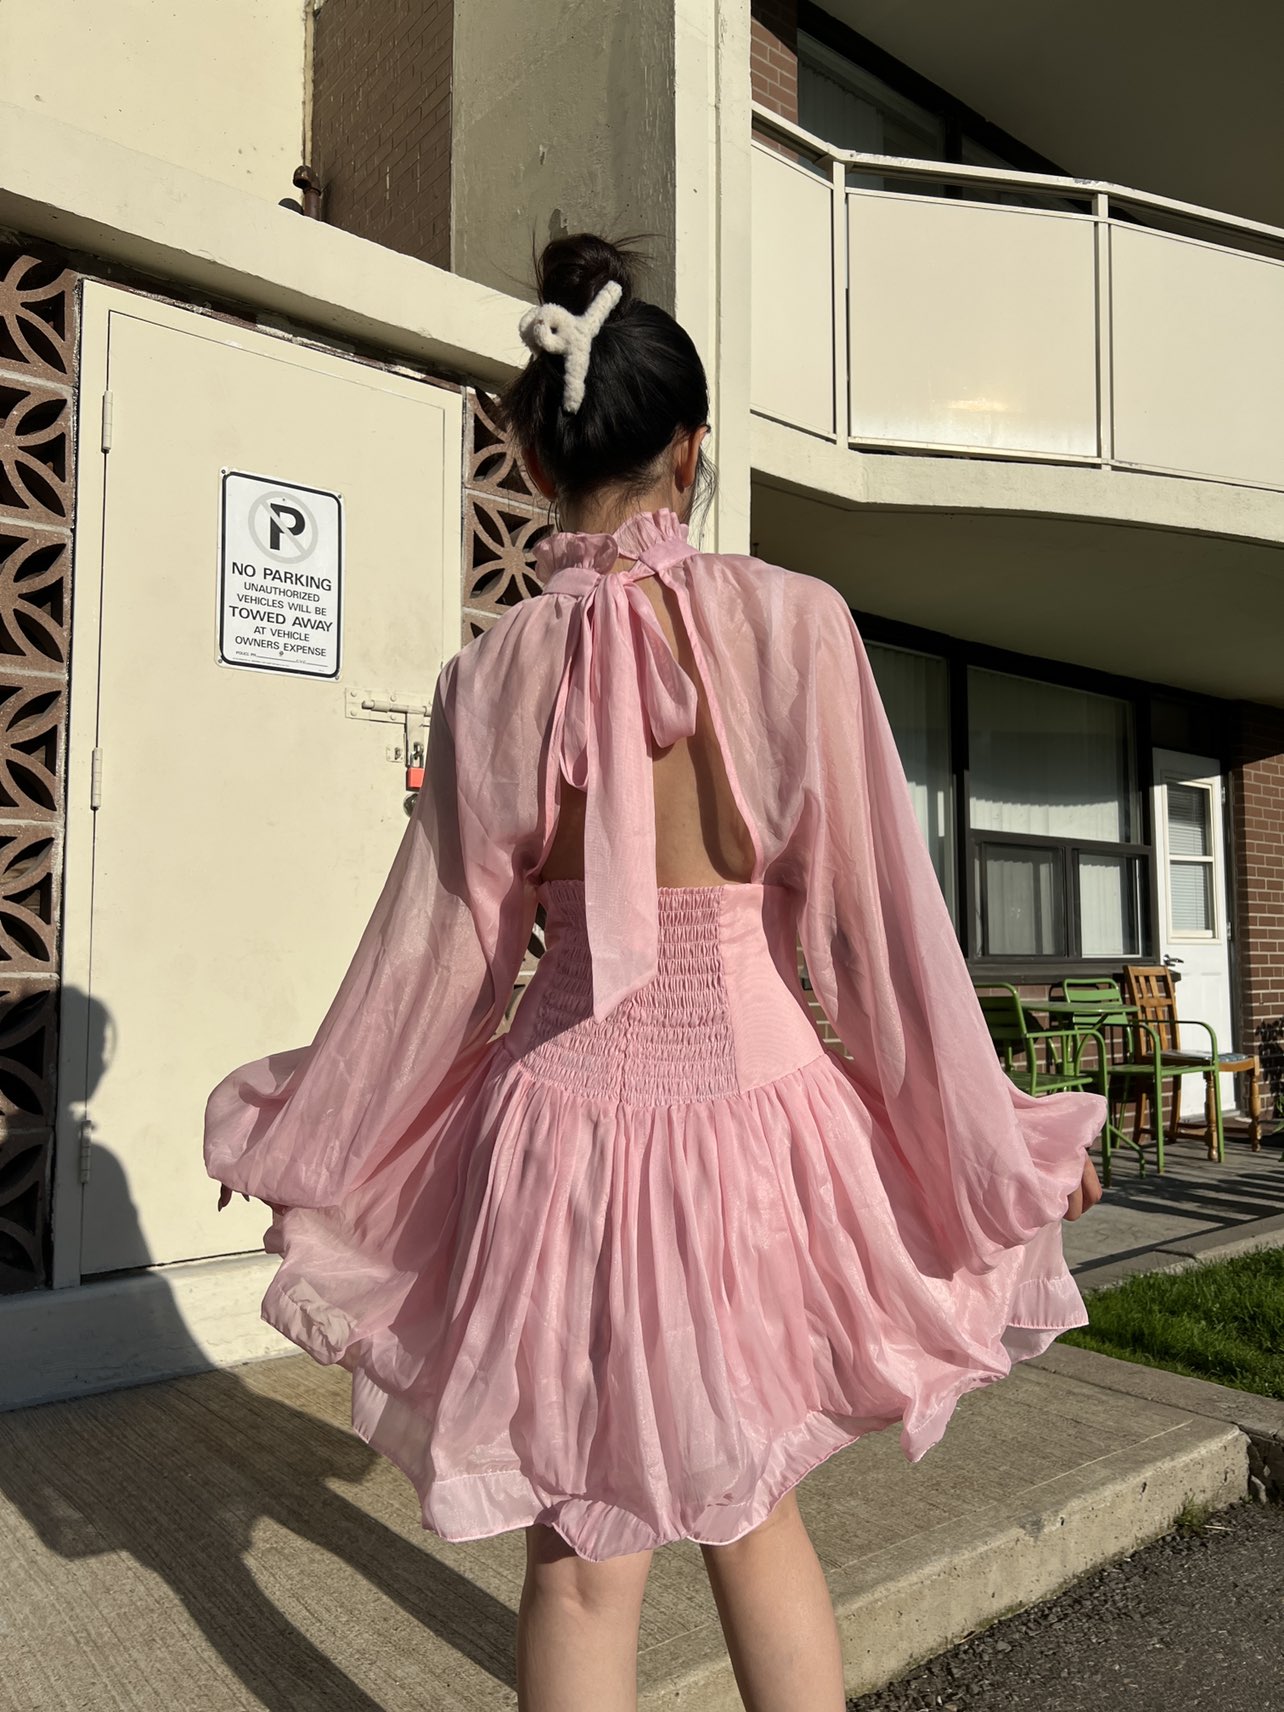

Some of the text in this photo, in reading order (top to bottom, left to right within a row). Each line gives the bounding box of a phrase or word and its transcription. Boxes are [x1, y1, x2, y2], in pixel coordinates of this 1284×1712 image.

[269, 502, 306, 551] P
[232, 561, 332, 591] NO PARKING
[243, 581, 320, 602] UNAUTHORIZED
[237, 593, 327, 616] VEHICLES WILL BE
[229, 605, 333, 632] TOWED AWAY
[253, 626, 310, 642] AT VEHICLE
[235, 635, 327, 657] OWNERS EXPENSE
